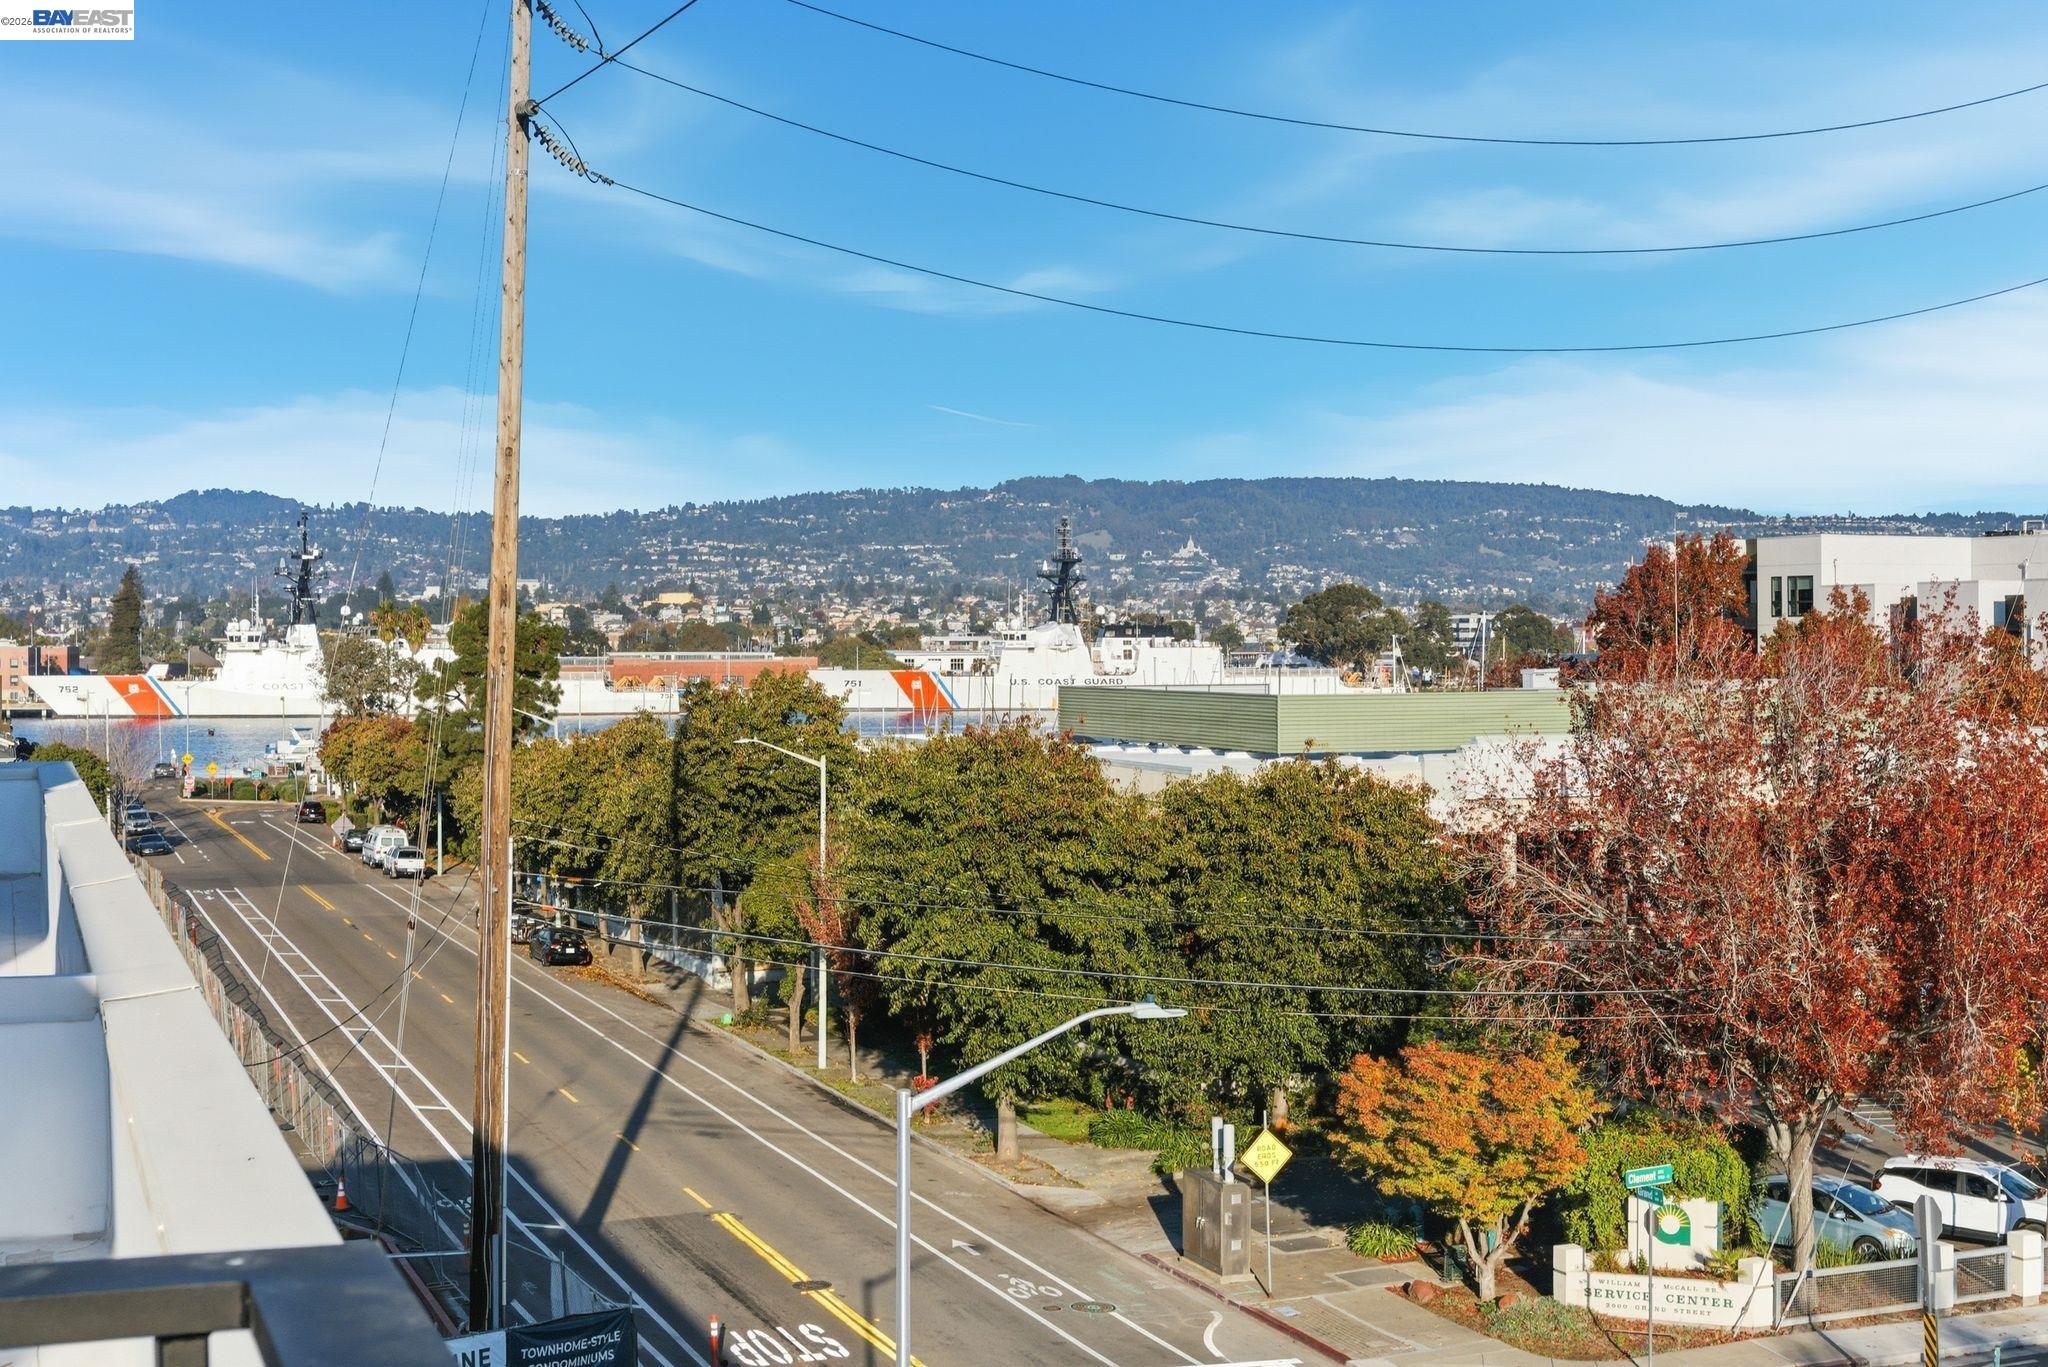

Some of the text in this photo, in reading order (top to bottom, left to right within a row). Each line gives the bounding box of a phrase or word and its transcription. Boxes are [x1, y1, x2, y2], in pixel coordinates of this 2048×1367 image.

[58, 685, 79, 694] 752
[1599, 1279, 1641, 1287] WILLIAM
[1584, 1287, 1734, 1308] SERVICE CENTER
[1673, 1308, 1712, 1317] STREET
[521, 1330, 621, 1359] TOWNHOME-STYLE
[729, 1323, 850, 1366] STOP
